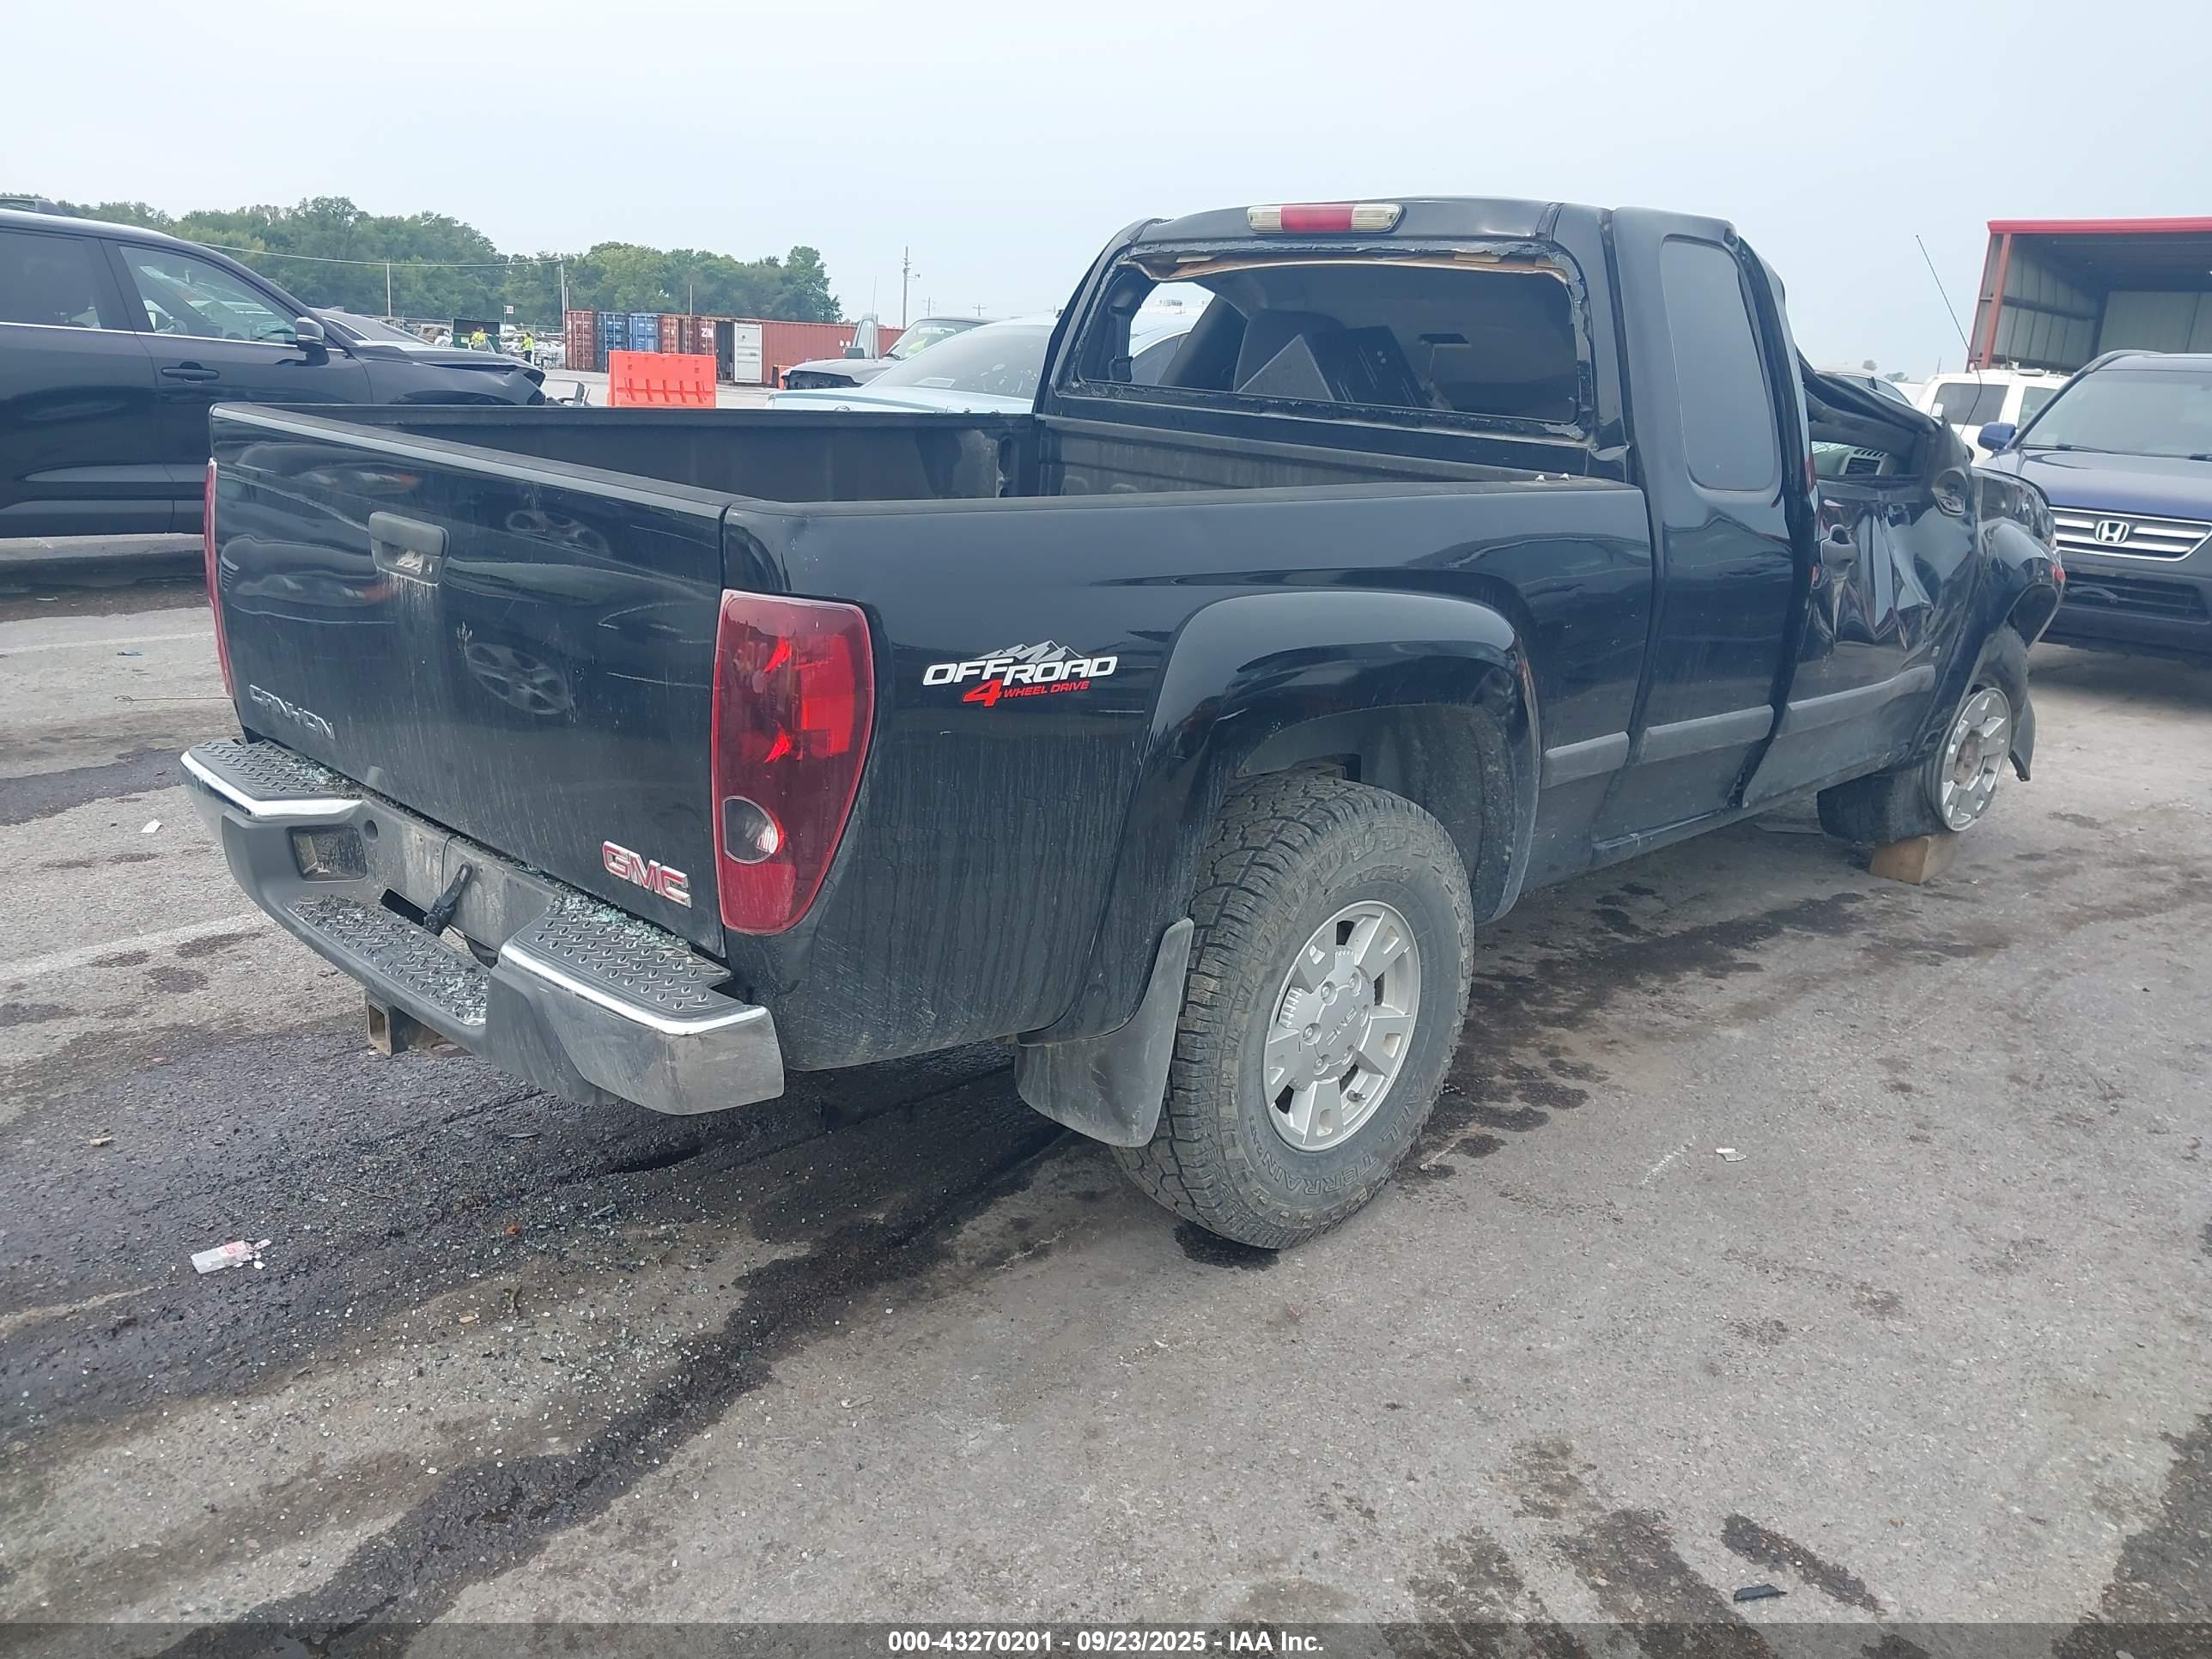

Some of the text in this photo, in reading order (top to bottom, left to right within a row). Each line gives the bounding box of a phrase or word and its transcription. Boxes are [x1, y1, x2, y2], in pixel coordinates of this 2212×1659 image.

[963, 679, 1091, 707] 4 WHEEL DRIVE
[602, 840, 692, 908] GMC
[1262, 1151, 1378, 1195] TERRAIN
